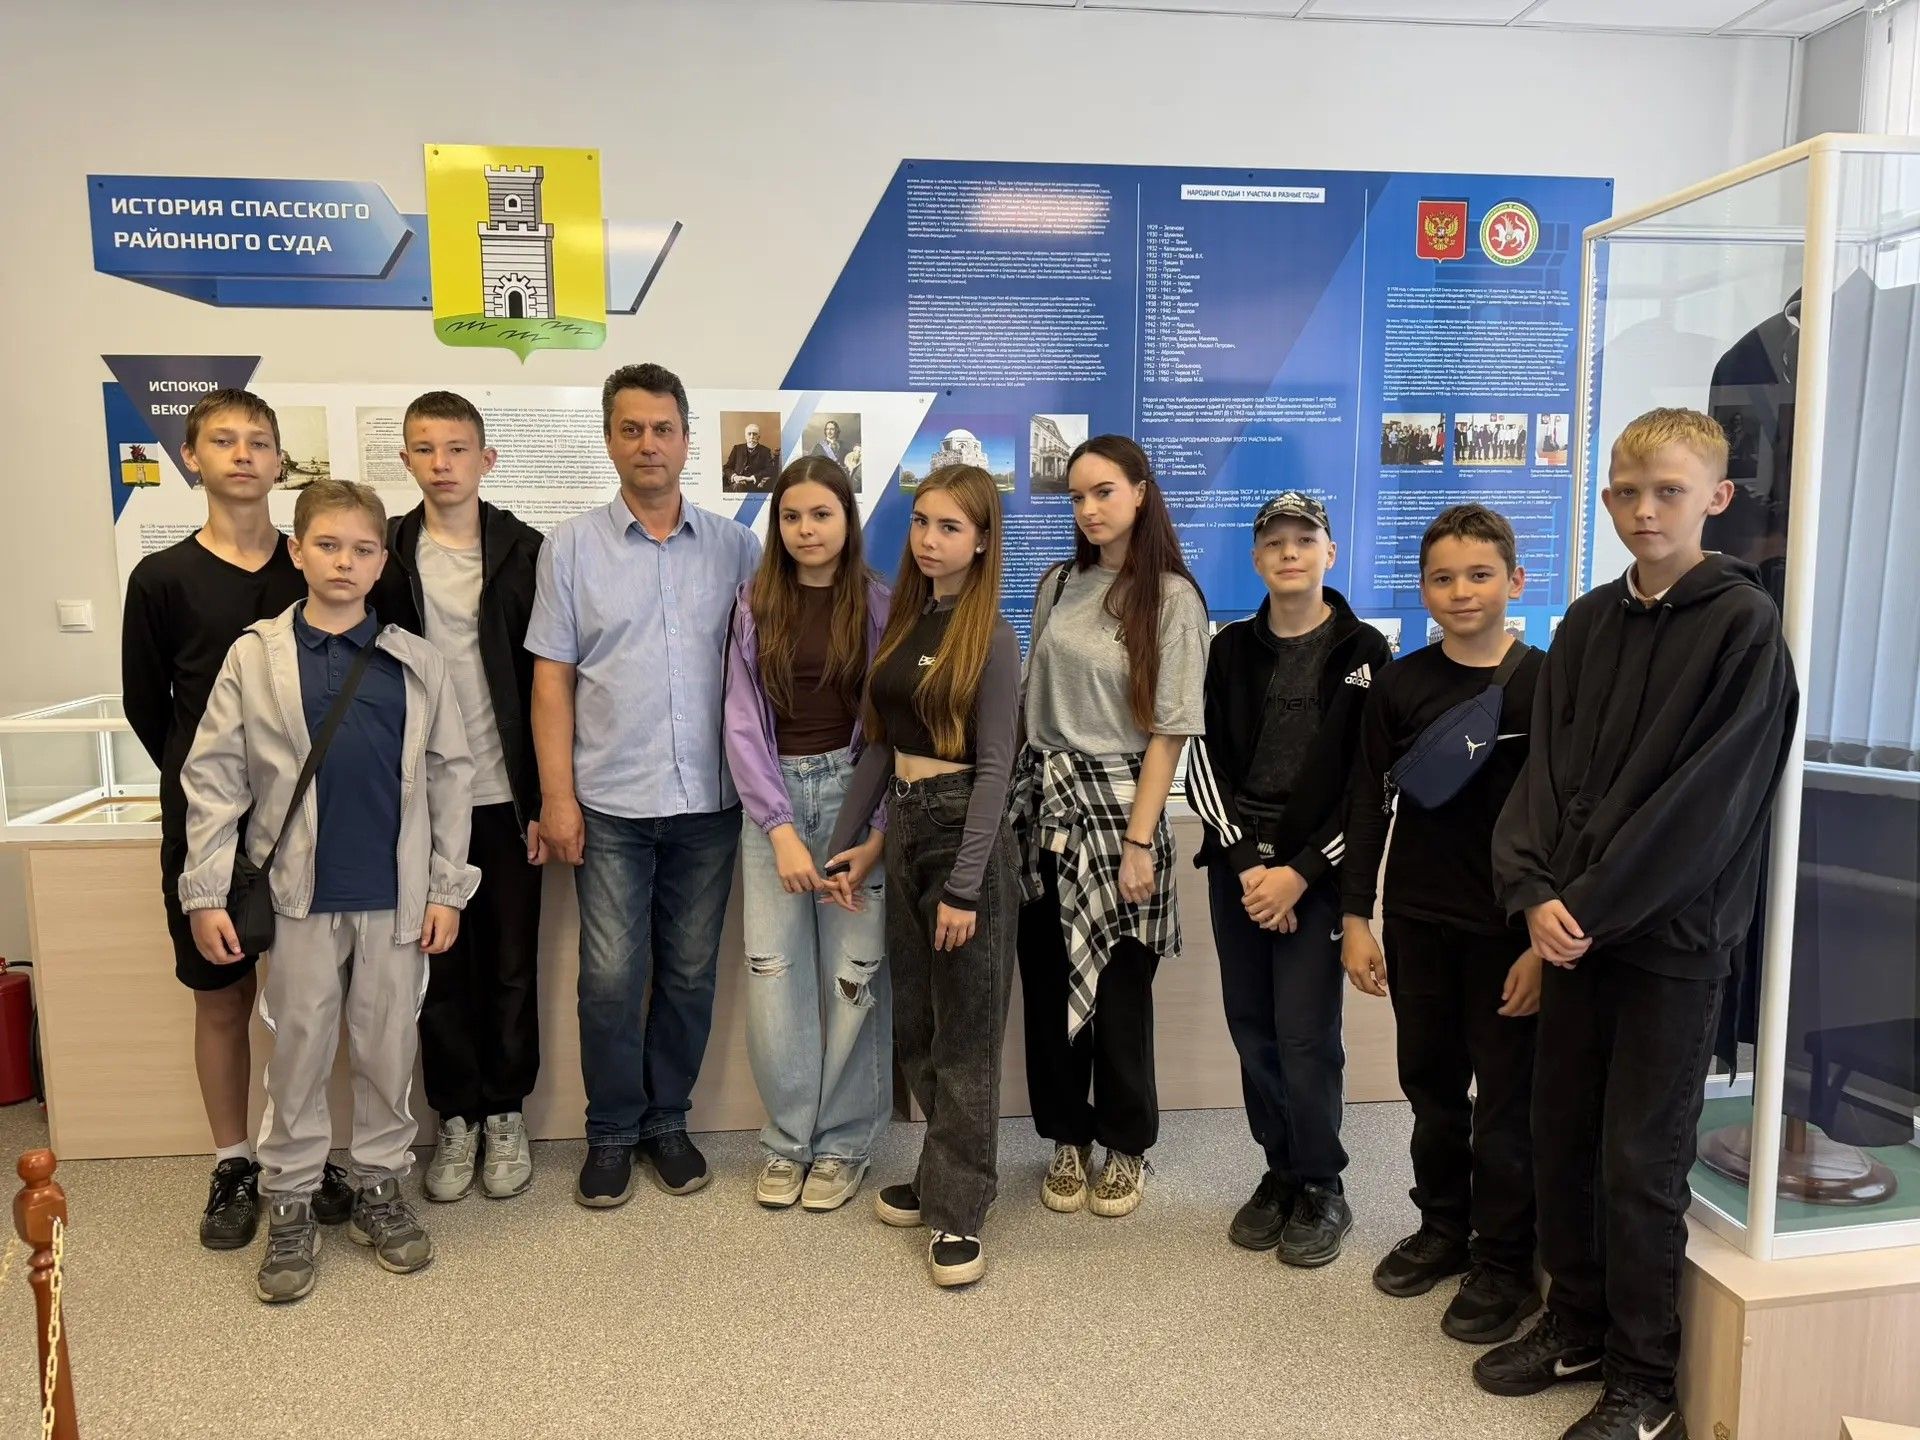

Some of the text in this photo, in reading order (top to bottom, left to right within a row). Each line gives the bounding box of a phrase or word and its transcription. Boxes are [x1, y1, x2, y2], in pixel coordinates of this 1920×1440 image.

[1186, 189, 1221, 197] НАРОДНЫЕ
[1222, 190, 1241, 198] СУДЬИ
[1247, 190, 1272, 198] УЧАСТКА
[1278, 191, 1302, 199] РАЗНЫЕ
[1302, 192, 1320, 200] ГОДЫ
[111, 198, 370, 219] ИСТОРИЯ СПАССКОГО
[114, 227, 333, 256] РАЙОННОГО СУДА
[149, 381, 219, 392] ИСПОКОН
